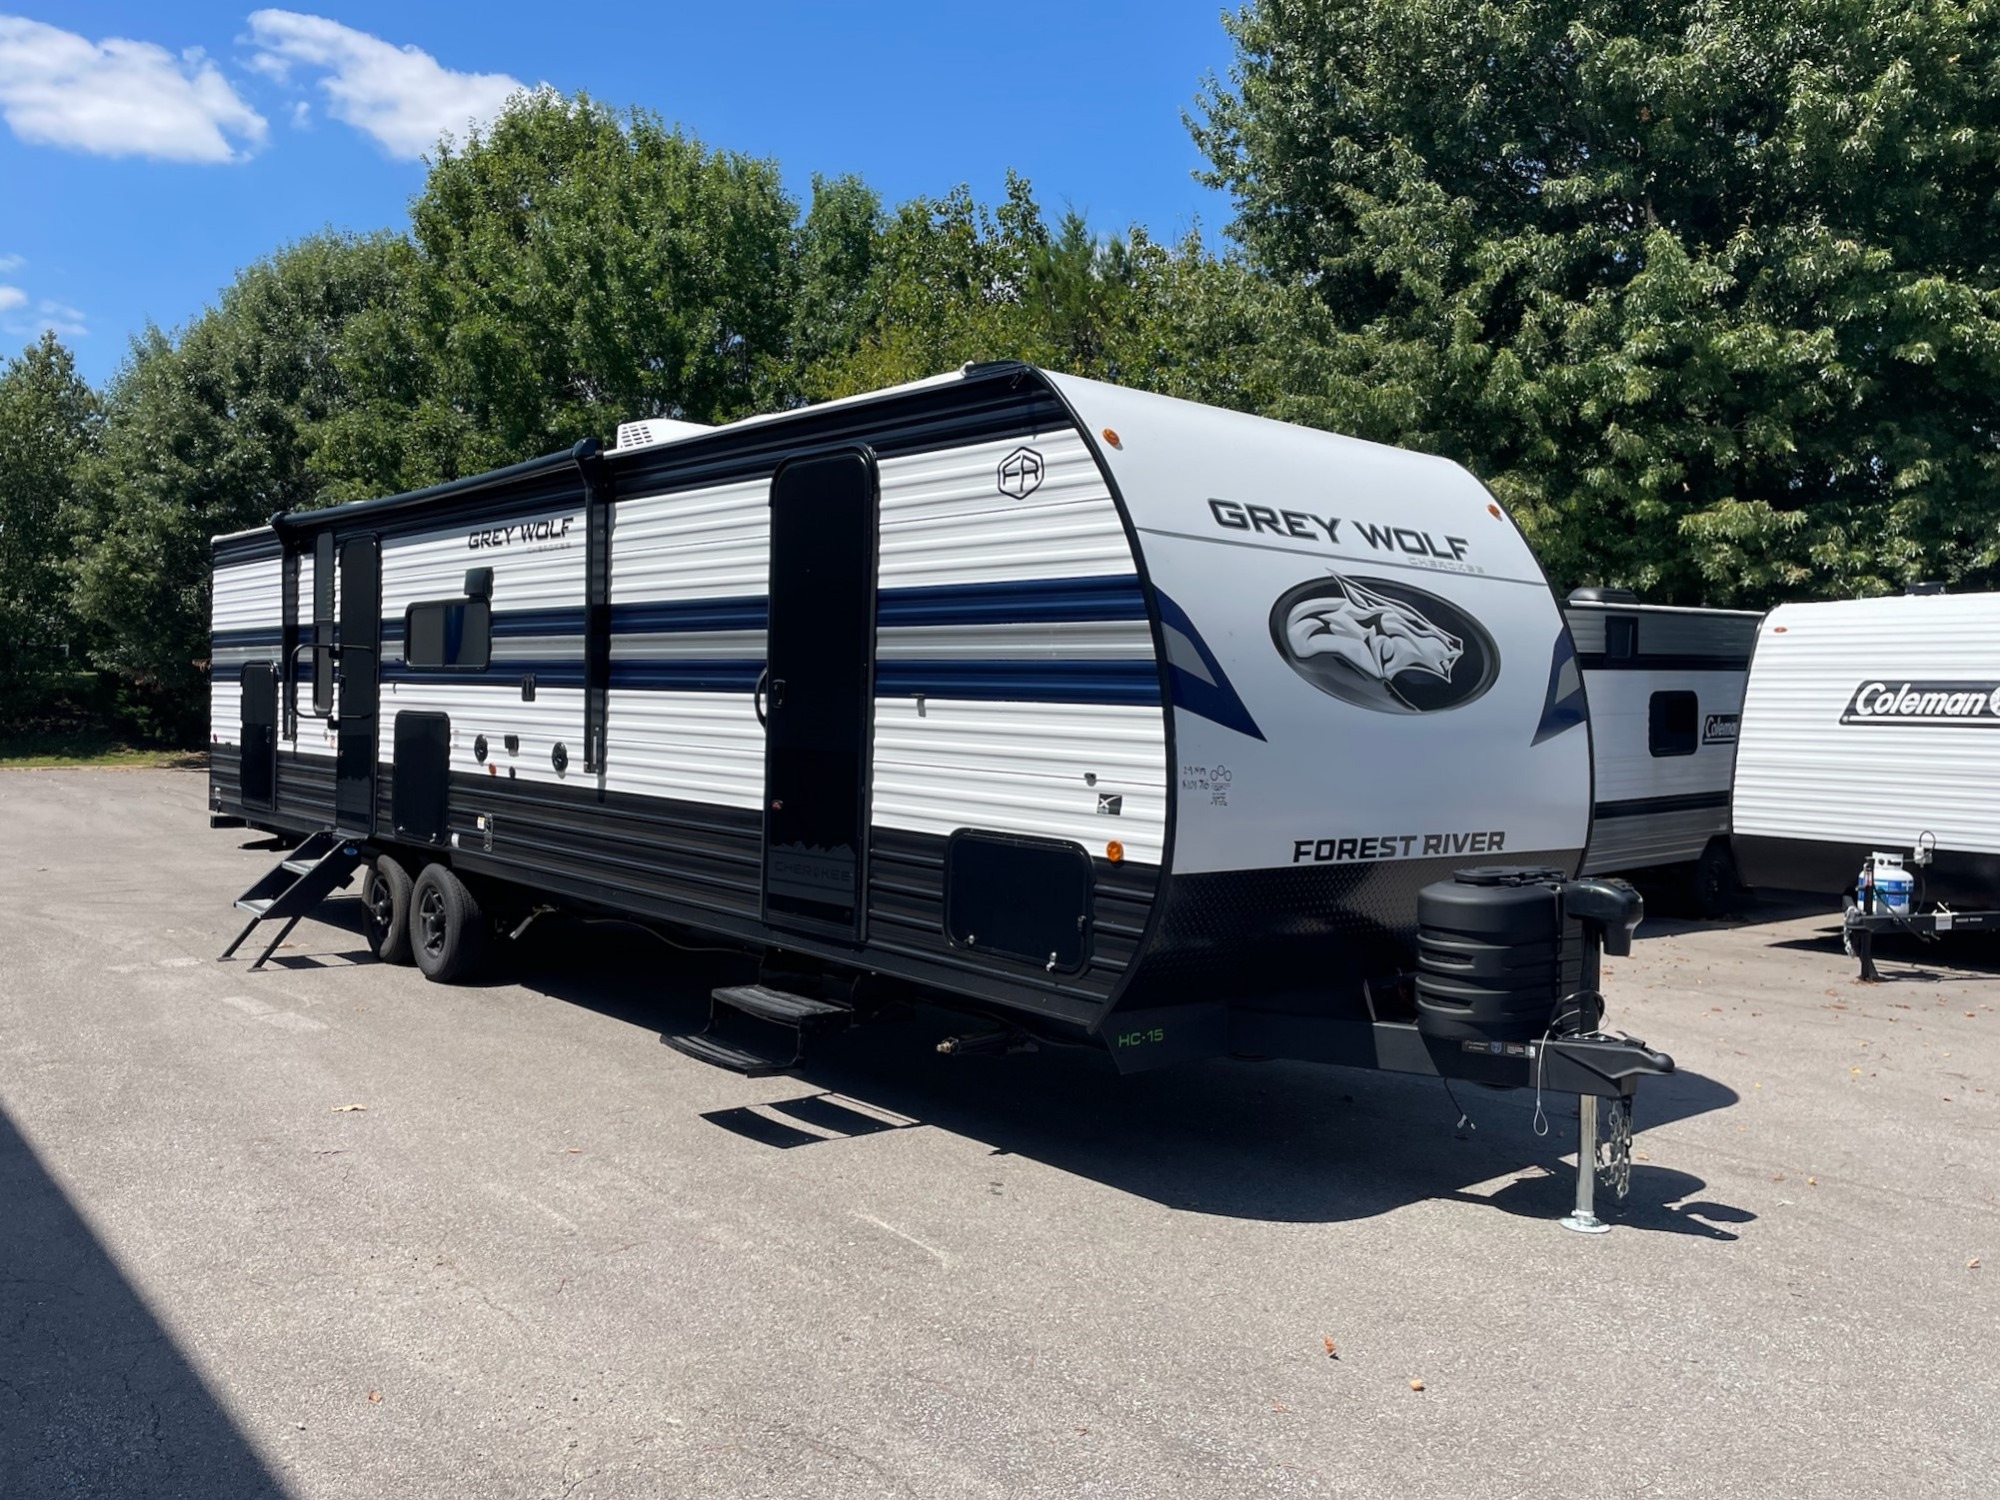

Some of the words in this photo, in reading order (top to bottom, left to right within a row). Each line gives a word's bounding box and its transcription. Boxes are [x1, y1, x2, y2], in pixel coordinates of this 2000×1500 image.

[468, 525, 517, 550] GREY
[520, 517, 574, 543] WOLF
[1207, 498, 1341, 544] GREY
[1351, 520, 1469, 561] WOLF
[1408, 556, 1485, 574] CHEROKEE
[1855, 682, 1988, 716] Coleman
[1705, 716, 1737, 738] Colema
[1293, 835, 1418, 863] FOREST
[1422, 831, 1505, 856] RIVER
